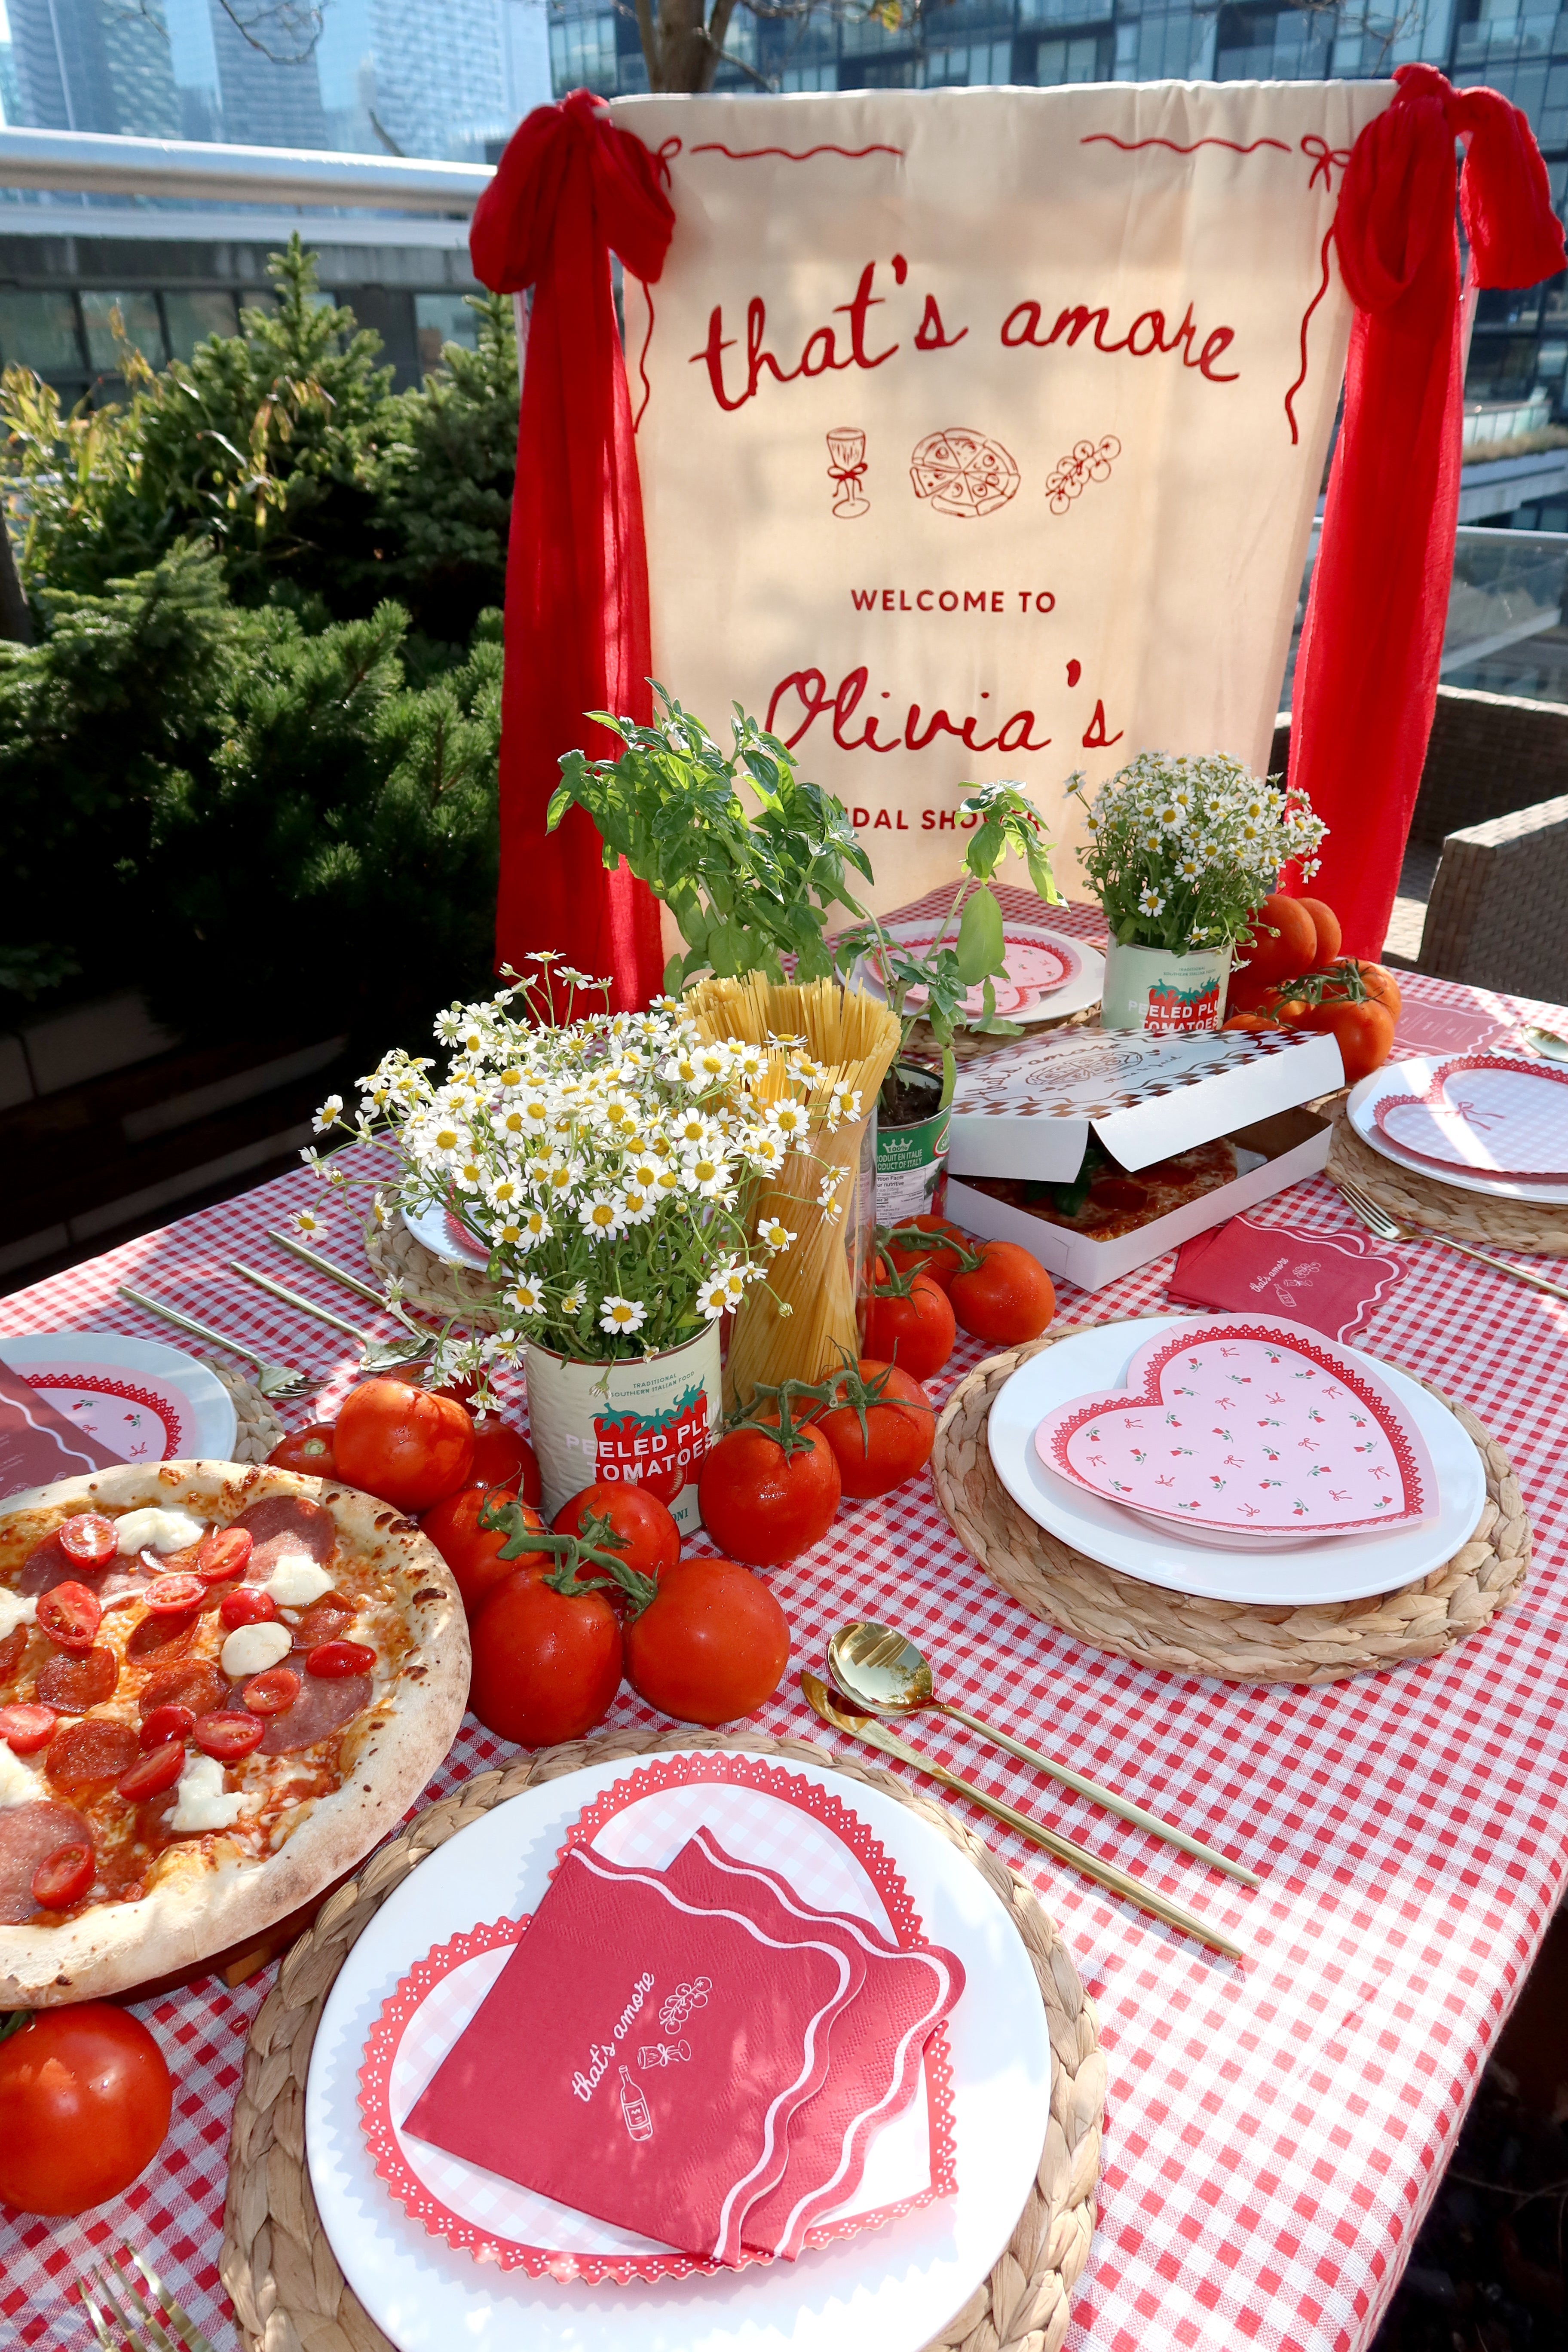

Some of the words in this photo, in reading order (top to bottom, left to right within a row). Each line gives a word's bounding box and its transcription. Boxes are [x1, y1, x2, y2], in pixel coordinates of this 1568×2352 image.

[690, 254, 968, 411] that's
[1001, 300, 1240, 383] amore
[851, 590, 1004, 612] WELCOME
[1019, 591, 1056, 613] TO
[764, 658, 1124, 752] Olivia's
[844, 807, 909, 830] DAL
[921, 809, 1041, 832] SHO
[1128, 1000, 1193, 1019] PEELED
[1139, 1015, 1219, 1030] TOMATOES
[964, 1067, 1023, 1096] that's
[1028, 1043, 1128, 1065] amore
[877, 1154, 897, 1163] ODUIT
[906, 1149, 923, 1160] ITALIE
[877, 1162, 898, 1170] ODUCT
[907, 1157, 922, 1168] ITALY
[1249, 1276, 1271, 1292] that's
[1268, 1258, 1289, 1277] amore
[611, 1389, 649, 1397] SOUTHERN
[652, 1381, 677, 1392] ITALIAN
[679, 1371, 695, 1383] FOOD
[633, 1373, 677, 1388] TRADITIONAL
[566, 1433, 667, 1458] PEELED
[587, 1430, 713, 1481] TOMATOES
[572, 2042, 616, 2102] that's
[614, 1972, 655, 2039] amore
